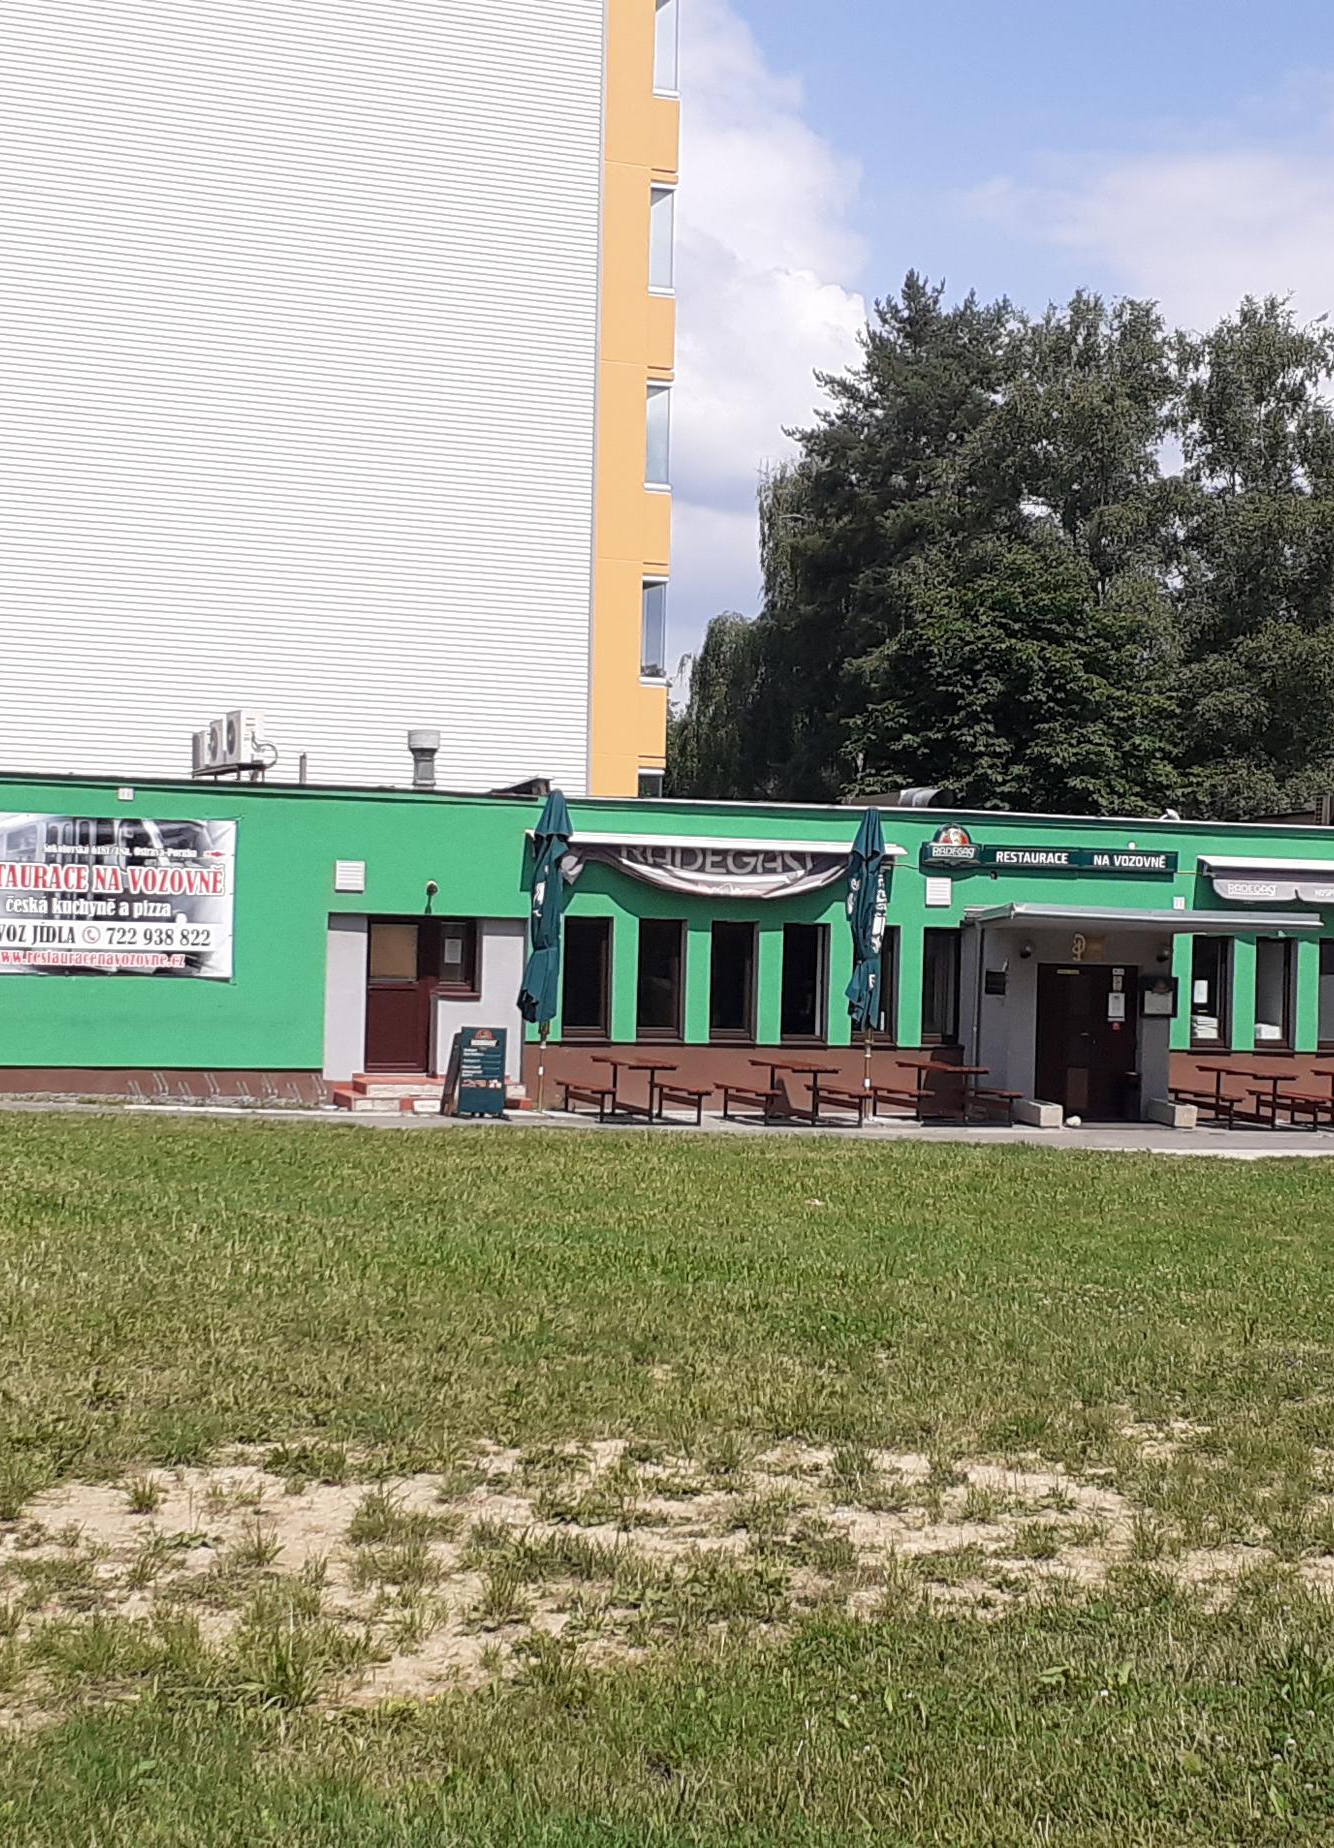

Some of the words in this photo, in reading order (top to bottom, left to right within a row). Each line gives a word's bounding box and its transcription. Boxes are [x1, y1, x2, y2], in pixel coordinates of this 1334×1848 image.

[996, 851, 1069, 865] RESTAURACE
[1093, 854, 1109, 867] NA
[1114, 854, 1166, 868] VOZOVNĚ
[94, 867, 121, 891] NA
[128, 865, 224, 894] VOZOVNĚ
[5, 895, 48, 913] česká
[52, 897, 116, 917] kuchyně
[119, 902, 130, 916] a
[133, 900, 171, 919] pizza
[31, 921, 76, 945] JÍDLA
[106, 927, 137, 945] 722
[143, 928, 175, 946] 938
[180, 929, 211, 947] 822
